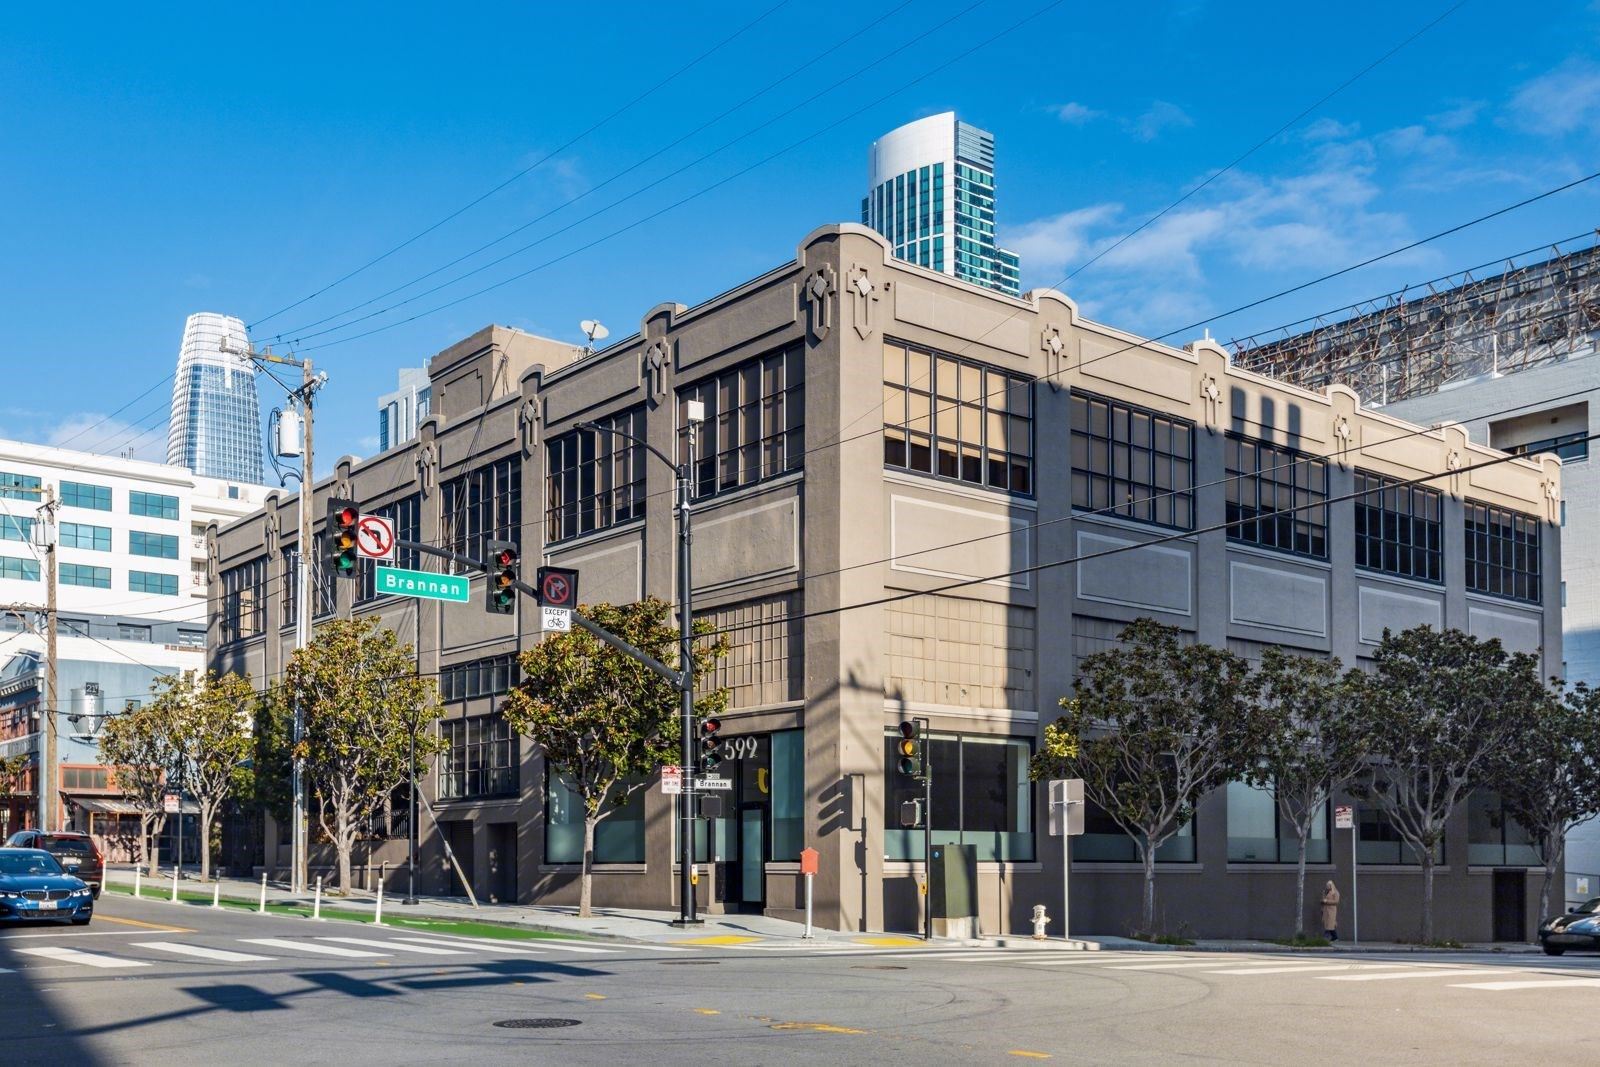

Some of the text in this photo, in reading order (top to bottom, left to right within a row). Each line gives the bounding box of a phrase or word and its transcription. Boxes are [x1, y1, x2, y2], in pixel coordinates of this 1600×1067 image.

[386, 574, 460, 596] Brannan
[544, 608, 568, 617] EXCEPT
[724, 736, 758, 760] 599
[700, 779, 728, 788] Brannan
